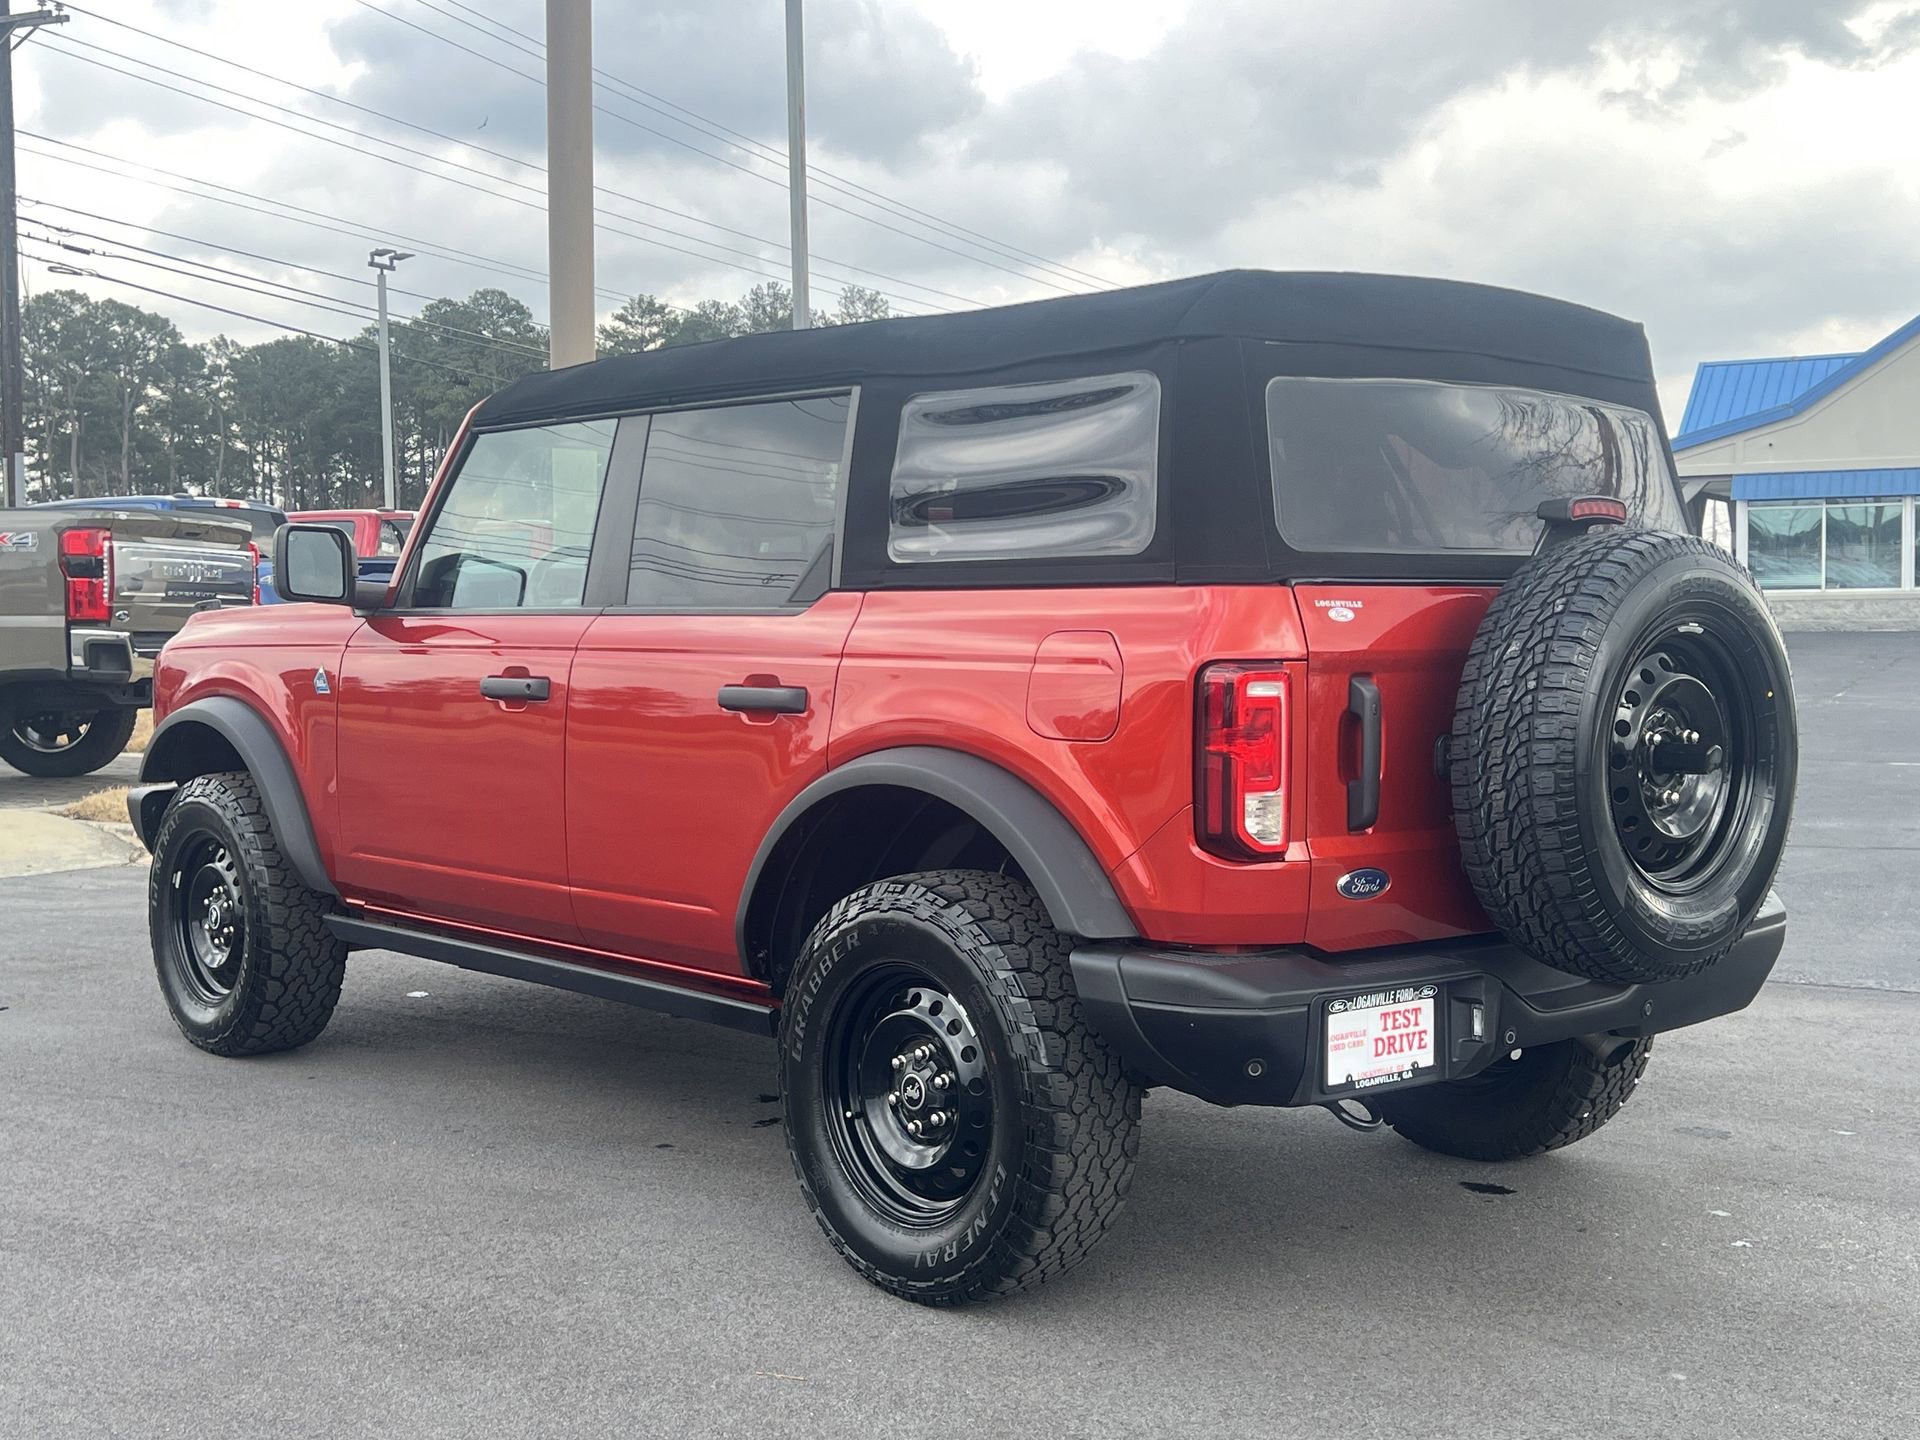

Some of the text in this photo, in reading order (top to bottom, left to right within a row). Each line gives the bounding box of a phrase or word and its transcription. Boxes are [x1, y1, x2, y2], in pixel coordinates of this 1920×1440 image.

[1314, 600, 1364, 608] LOGANVILLE
[1351, 877, 1380, 893] Ford
[791, 931, 861, 1062] GRABBER
[1352, 988, 1414, 1010] LOGANVILLE FORD
[1380, 1007, 1422, 1031] TEST
[1373, 1030, 1427, 1057] DRIVE
[1355, 1070, 1413, 1089] LOGANVILLE, GA
[907, 1163, 1007, 1268] GENERAL
